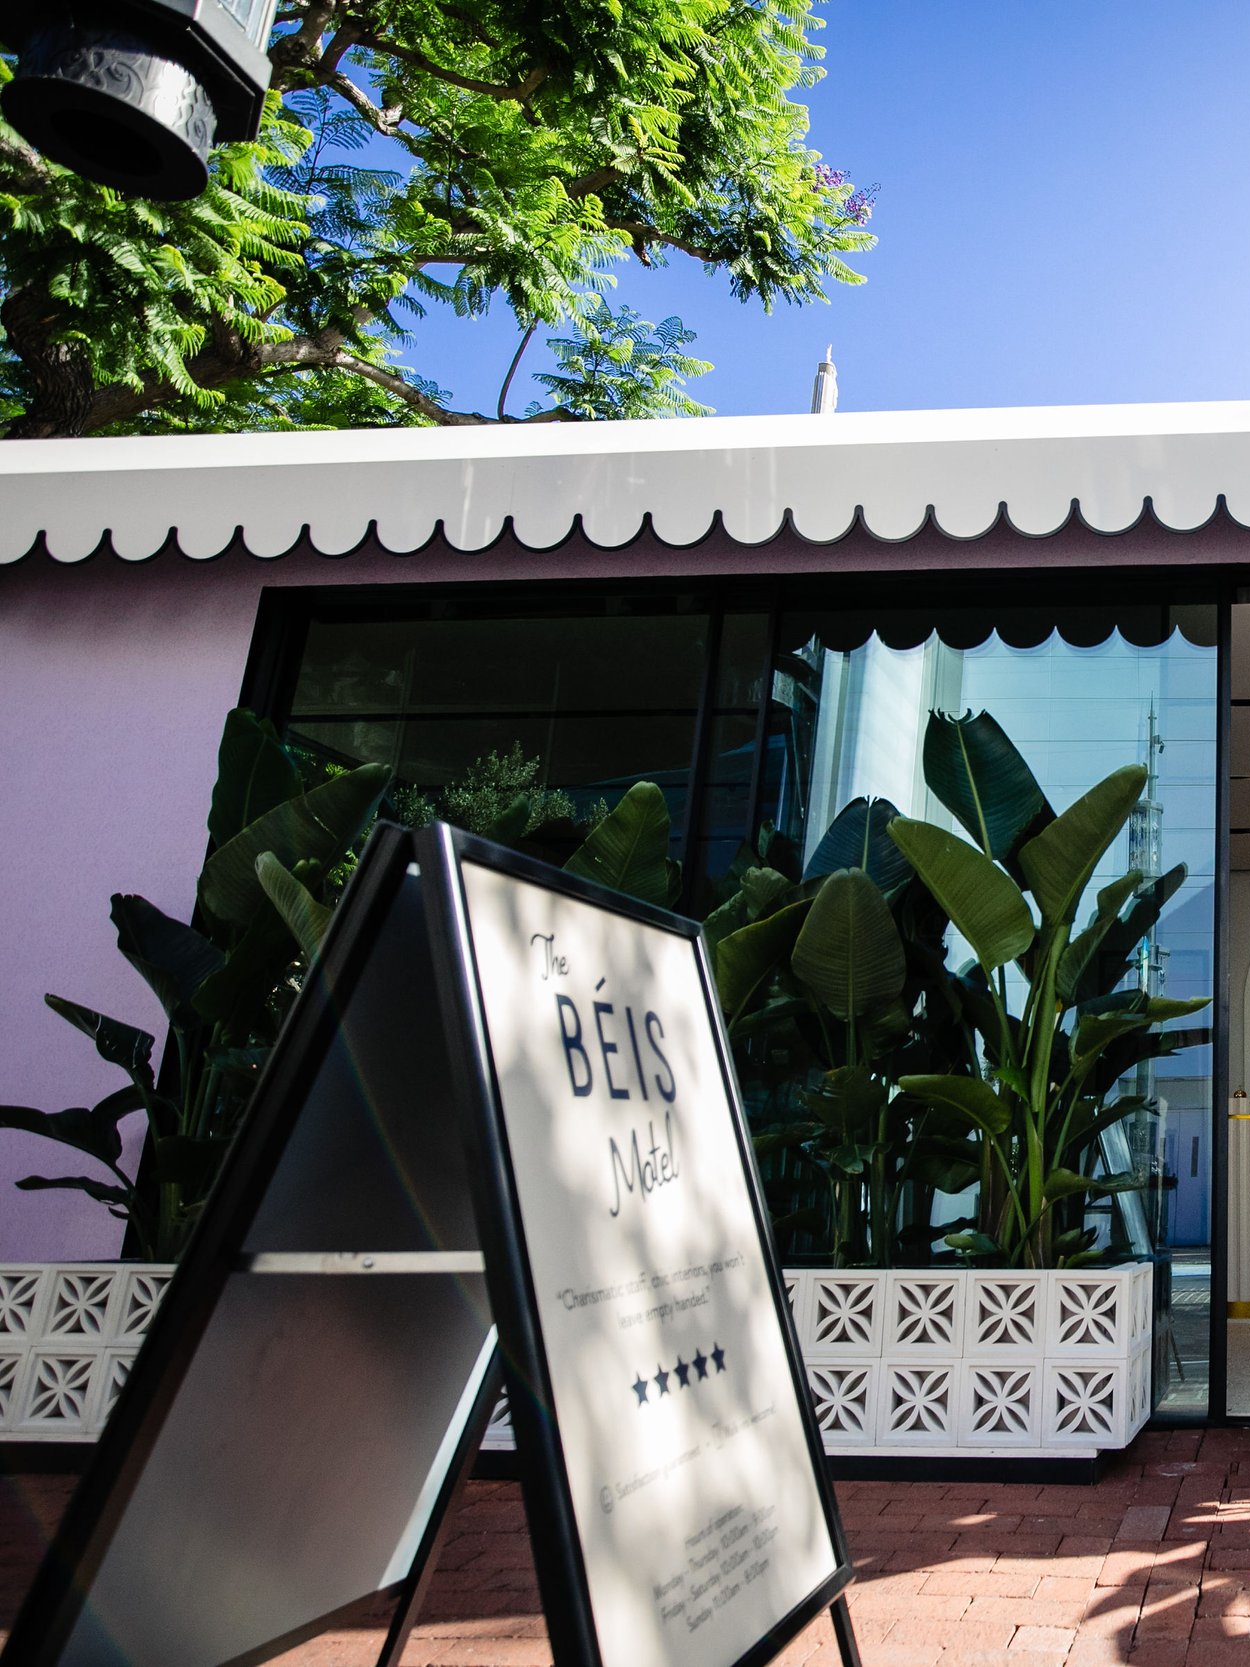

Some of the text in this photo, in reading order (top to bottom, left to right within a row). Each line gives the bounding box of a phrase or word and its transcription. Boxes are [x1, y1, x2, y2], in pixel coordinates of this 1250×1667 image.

[530, 933, 570, 981] The
[555, 977, 677, 1103] BÉIS
[609, 1110, 680, 1218] Motel
